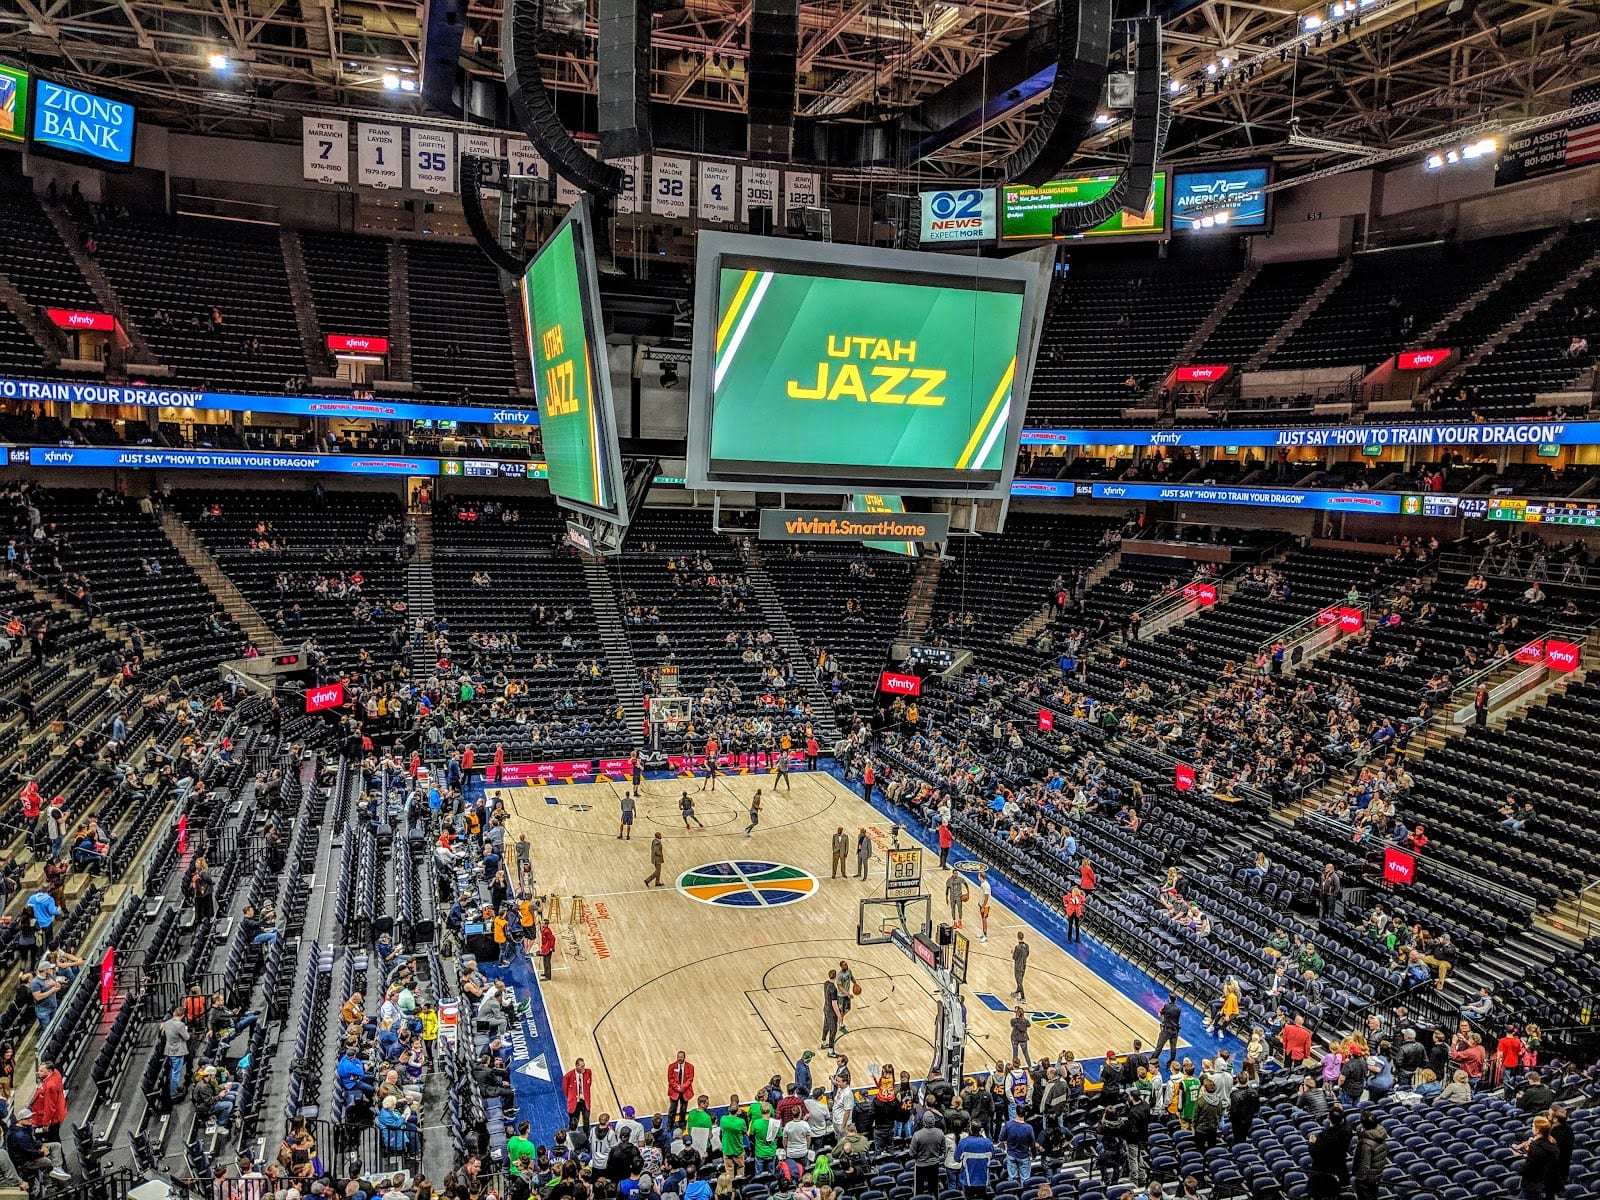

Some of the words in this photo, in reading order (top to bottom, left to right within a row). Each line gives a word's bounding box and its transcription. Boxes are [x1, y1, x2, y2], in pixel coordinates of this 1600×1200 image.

[44, 83, 123, 125] ZIONS
[308, 129, 343, 139] MARAVICH
[368, 128, 391, 136] FRANK
[418, 134, 446, 142] DARRELL
[367, 136, 392, 144] LAYDEN
[418, 142, 446, 150] GRIFFITH
[1508, 138, 1531, 152] NEED
[319, 140, 333, 160] 7
[376, 147, 384, 166] 1
[418, 151, 446, 171] 35
[517, 161, 539, 176] 14
[658, 178, 683, 196] 32
[710, 184, 722, 200] 4
[747, 188, 773, 201] 3051
[790, 192, 815, 204] 1223
[1178, 192, 1226, 206] AMERICA
[953, 190, 984, 218] 2
[931, 218, 984, 230] NEWS
[930, 230, 959, 240] EXPECT
[960, 229, 984, 238] MORE
[68, 314, 94, 326] xfinity
[346, 338, 370, 348] xfinity
[542, 324, 564, 361] UTAH
[828, 335, 916, 362] UTAH
[1413, 354, 1434, 366] xfinity
[1192, 369, 1212, 378] xfinity
[546, 360, 579, 417] JAZZ
[786, 362, 947, 406] JAZZ
[19, 382, 70, 400] TRAIN
[73, 386, 120, 404] YOUR
[493, 410, 530, 424] xfinity
[1150, 432, 1182, 446] xfinity
[1276, 432, 1306, 445] JUST
[1306, 430, 1330, 444] SAY
[1370, 428, 1388, 444] TO
[1390, 427, 1433, 444] TRAIN
[1436, 426, 1479, 443] YOUR
[44, 451, 74, 463] xfinity
[119, 454, 144, 464] JUST
[144, 454, 164, 464] SAY
[198, 456, 210, 465] TO
[212, 456, 242, 466] TRAIN
[243, 457, 270, 466] YOUR
[499, 463, 526, 473] 47:12
[1103, 487, 1126, 496] xfinity
[1160, 489, 1178, 497] JUST
[1180, 490, 1194, 498] SAY
[1218, 492, 1227, 500] TO
[1228, 492, 1248, 501] TRAIN
[1250, 493, 1270, 502] YOUR
[864, 494, 884, 506] UTAH
[1458, 498, 1488, 511] 47:12
[1444, 507, 1450, 515] 0
[1496, 510, 1502, 518] 0
[785, 517, 926, 536] vivint.SmartHome
[1342, 615, 1360, 625] xfinity
[1550, 650, 1574, 663] xfinity
[887, 678, 915, 690] xfinity
[312, 690, 338, 706] xfinity
[1388, 861, 1408, 876] xfinity
[594, 902, 611, 920] Arena
[1069, 1076, 1082, 1088] 45
[994, 1084, 1005, 1095] 45
[1014, 1084, 1027, 1098] 23
[595, 1140, 603, 1152] 11
